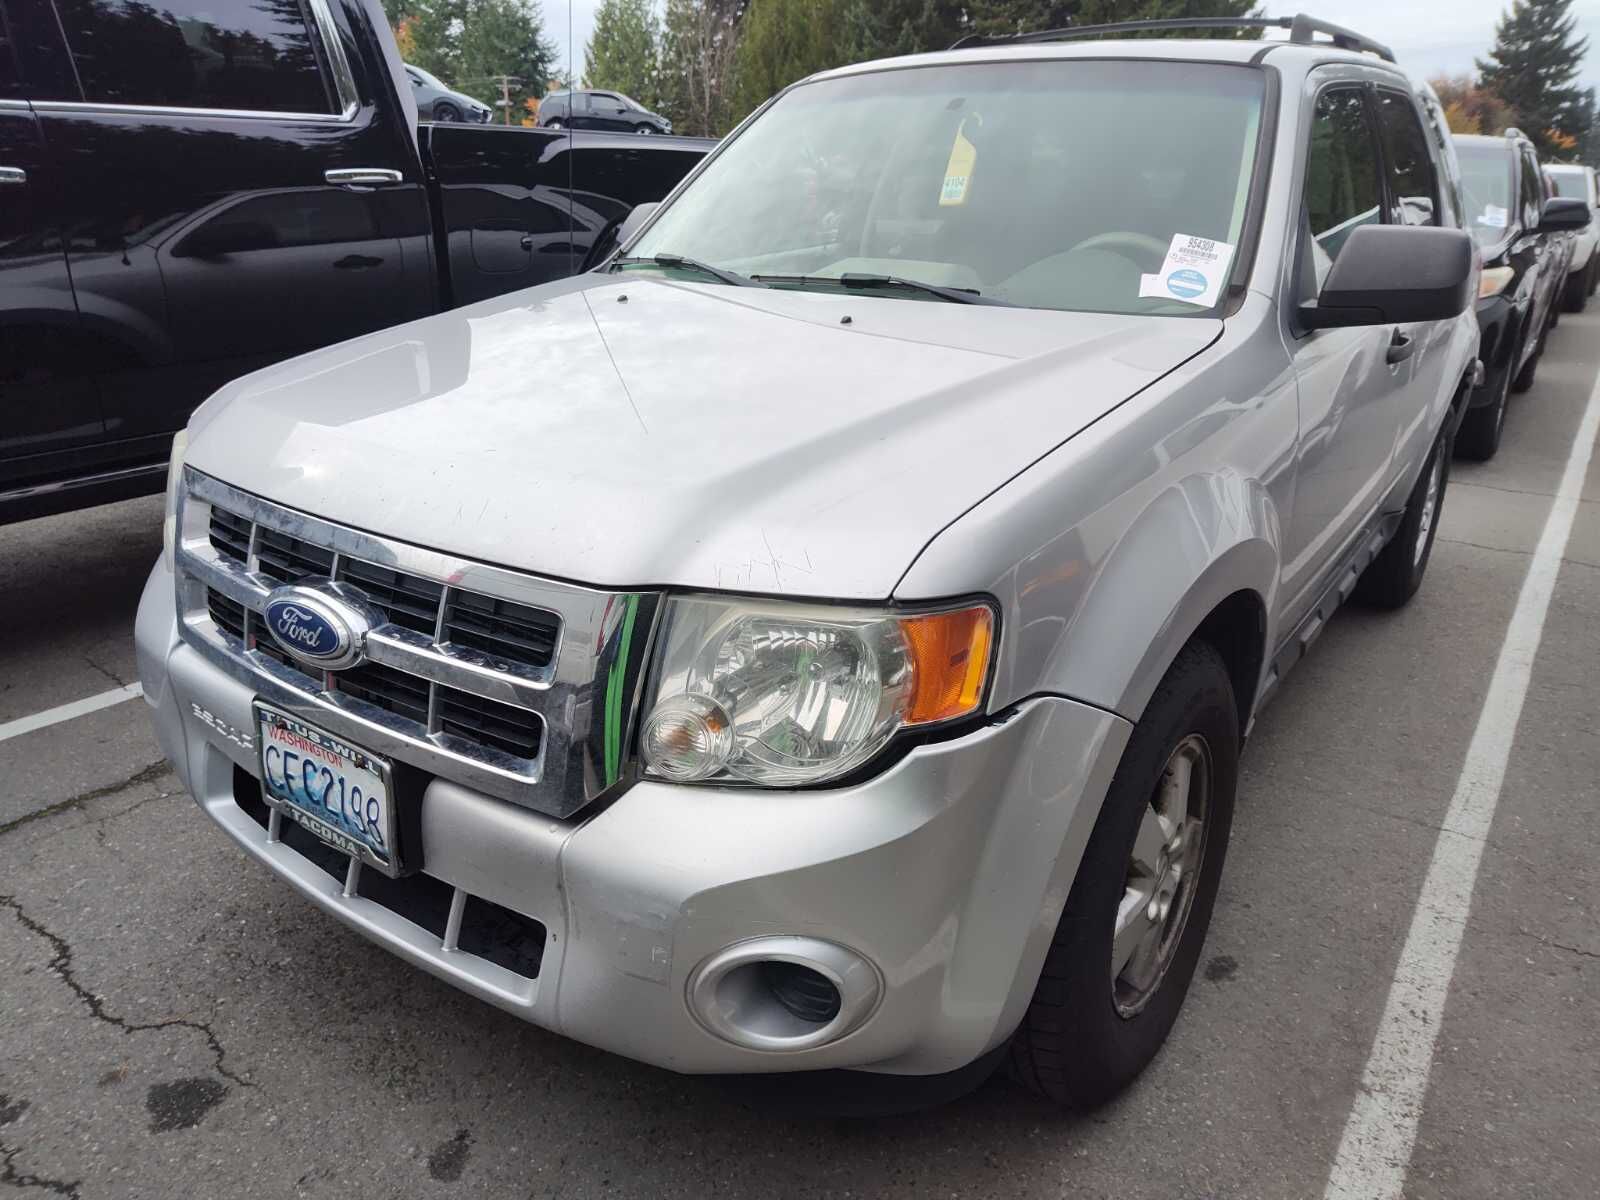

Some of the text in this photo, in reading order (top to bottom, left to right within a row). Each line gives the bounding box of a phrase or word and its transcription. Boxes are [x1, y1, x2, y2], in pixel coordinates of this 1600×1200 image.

[278, 606, 322, 647] Ford
[268, 724, 344, 769] WASHINGTON
[266, 744, 384, 847] CFC2198
[291, 808, 360, 856] TACOMA
